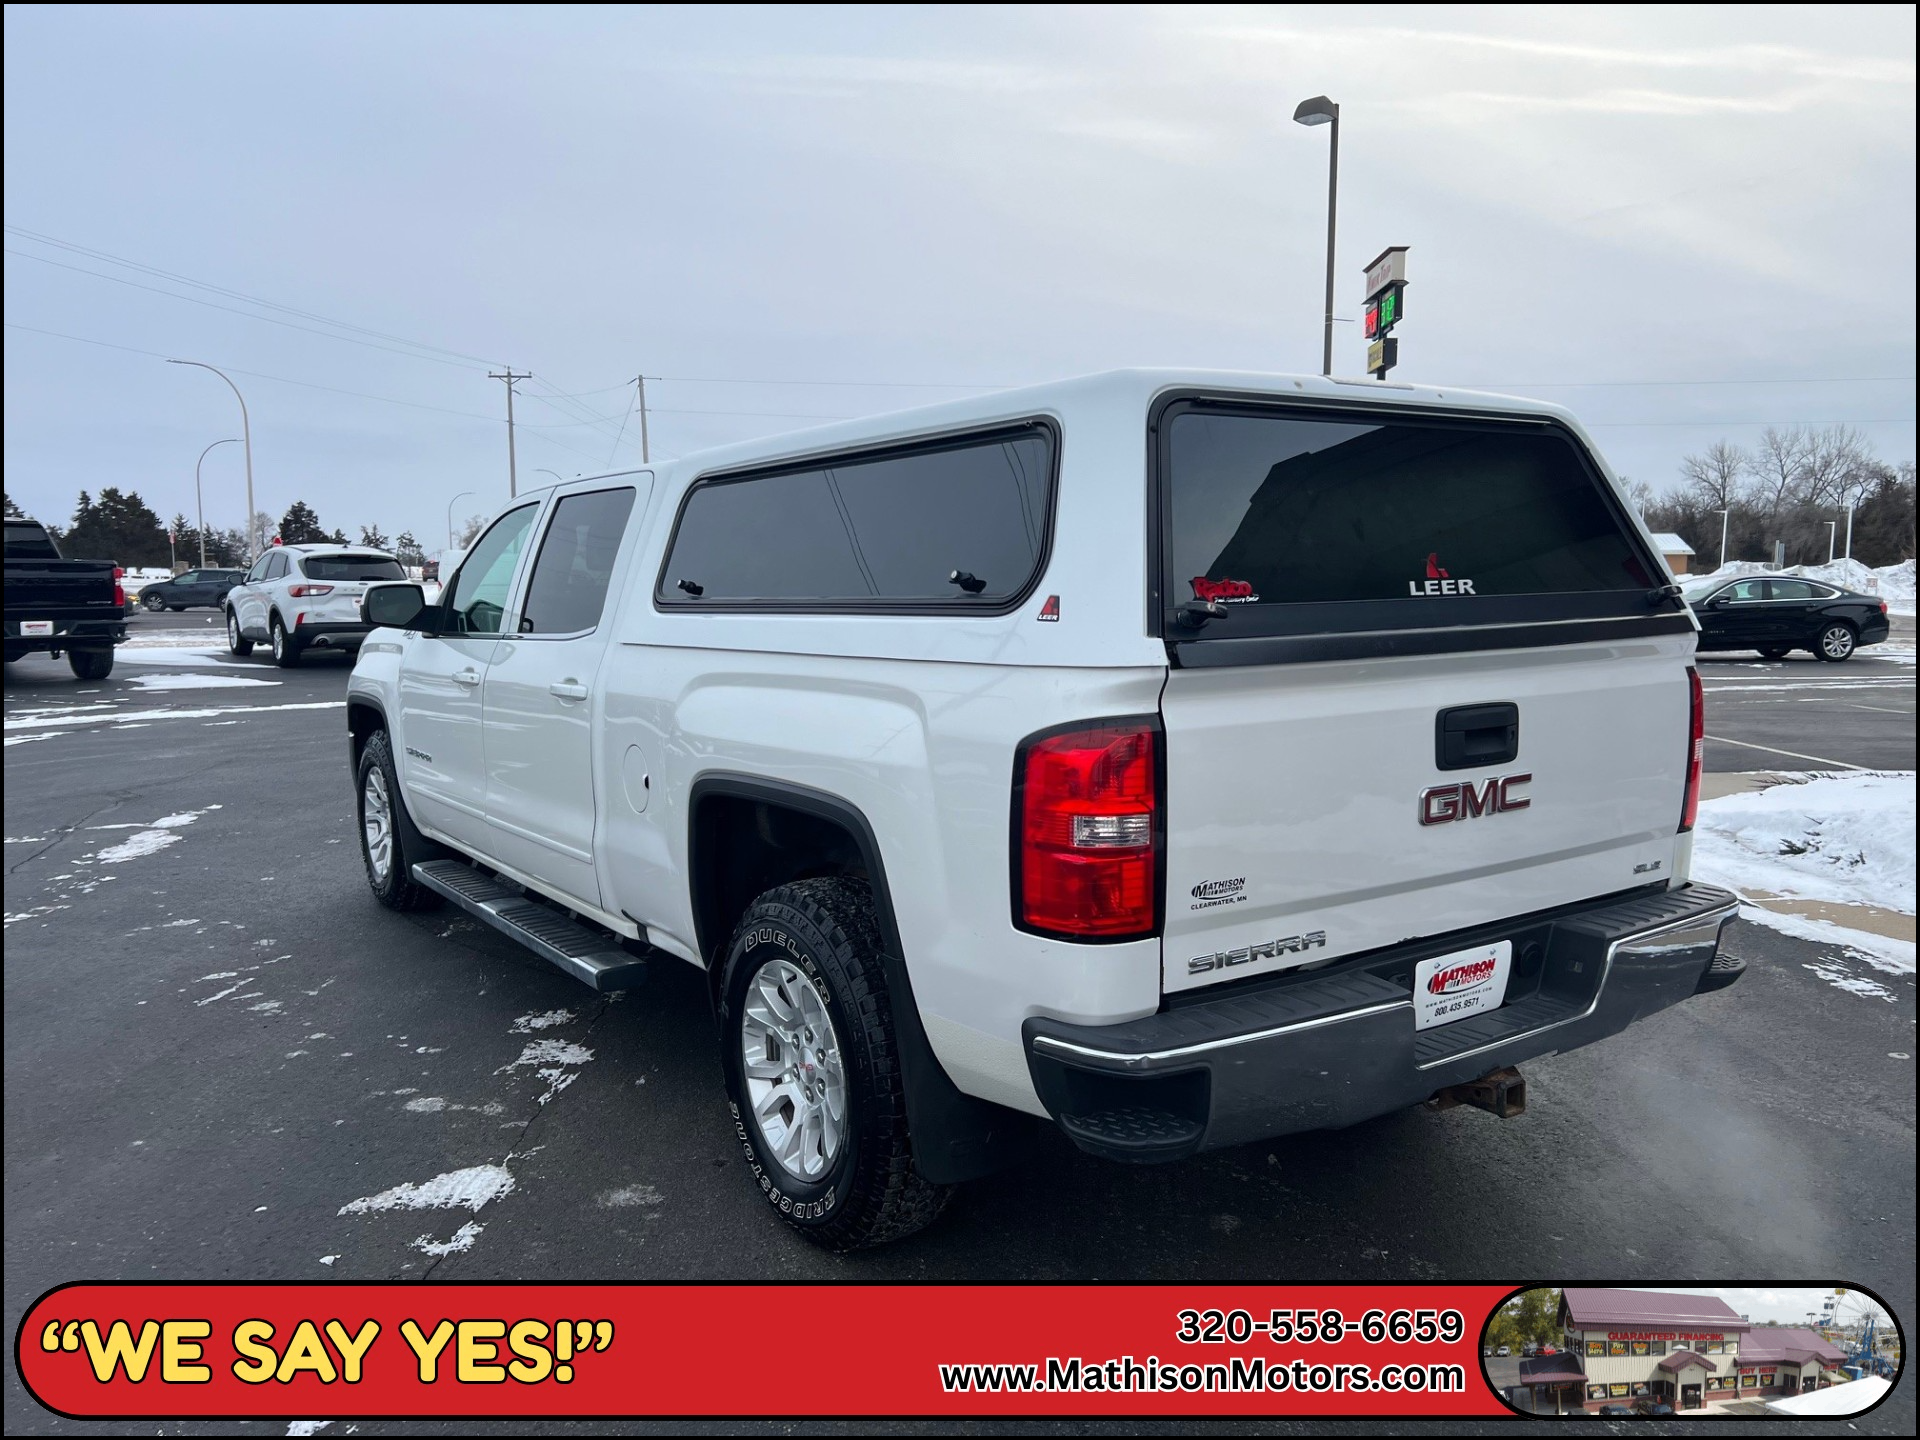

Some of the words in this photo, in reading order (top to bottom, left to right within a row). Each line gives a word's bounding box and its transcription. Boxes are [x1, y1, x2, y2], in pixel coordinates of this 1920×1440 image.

[1409, 579, 1476, 595] LEER
[1418, 772, 1532, 826] GMC
[1195, 877, 1246, 898] MATHISON
[1219, 886, 1243, 894] MOTORS
[1190, 898, 1236, 910] CLEARWATER,
[1187, 930, 1327, 976] SIERRA
[745, 928, 831, 1006] DUELER
[1430, 958, 1496, 994] MATHISON
[1460, 971, 1492, 985] MOTORS
[1434, 997, 1480, 1017] 800.435.9571
[729, 1101, 836, 1220] BRIDGESTONE
